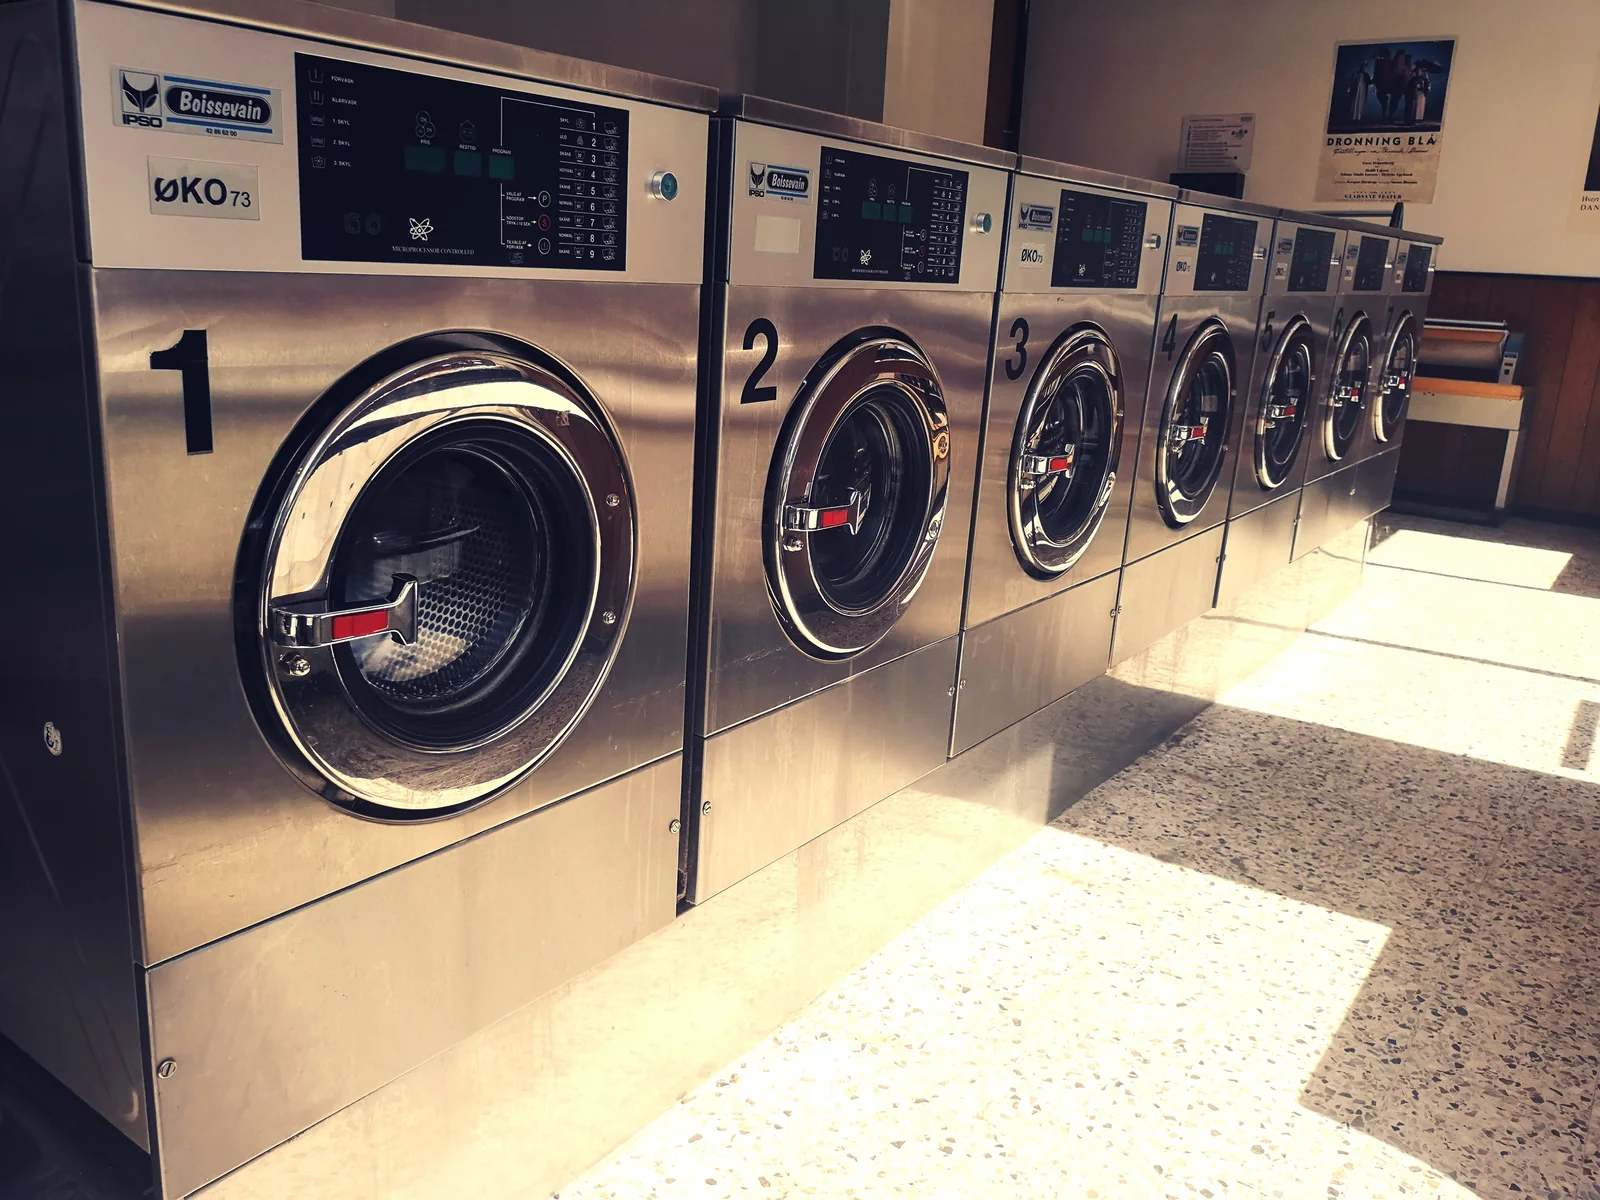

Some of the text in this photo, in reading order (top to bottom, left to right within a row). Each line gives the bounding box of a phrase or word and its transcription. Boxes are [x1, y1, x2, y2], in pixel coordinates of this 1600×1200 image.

[331, 75, 355, 84] FORVASK
[180, 90, 261, 120] Boissevain
[331, 97, 358, 106] KLARVASK
[122, 113, 163, 128] IPSO
[592, 122, 596, 131] 1
[591, 138, 596, 147] 2
[1327, 133, 1437, 147] DRONNING BLÅ
[591, 154, 596, 163] 3
[590, 170, 596, 180] 4
[771, 173, 805, 190] Boissevain
[154, 176, 251, 208] ØKO 73
[590, 186, 596, 196] 5
[590, 202, 596, 212] 6
[590, 218, 595, 227] 7
[589, 234, 595, 243] 8
[589, 250, 595, 259] 9
[1021, 249, 1038, 262] ØKO
[1333, 307, 1344, 342] 6
[1161, 313, 1178, 361] 4
[1262, 310, 1276, 353] 5
[1005, 317, 1030, 380] 3
[740, 317, 779, 404] 2
[150, 329, 213, 455] 1
